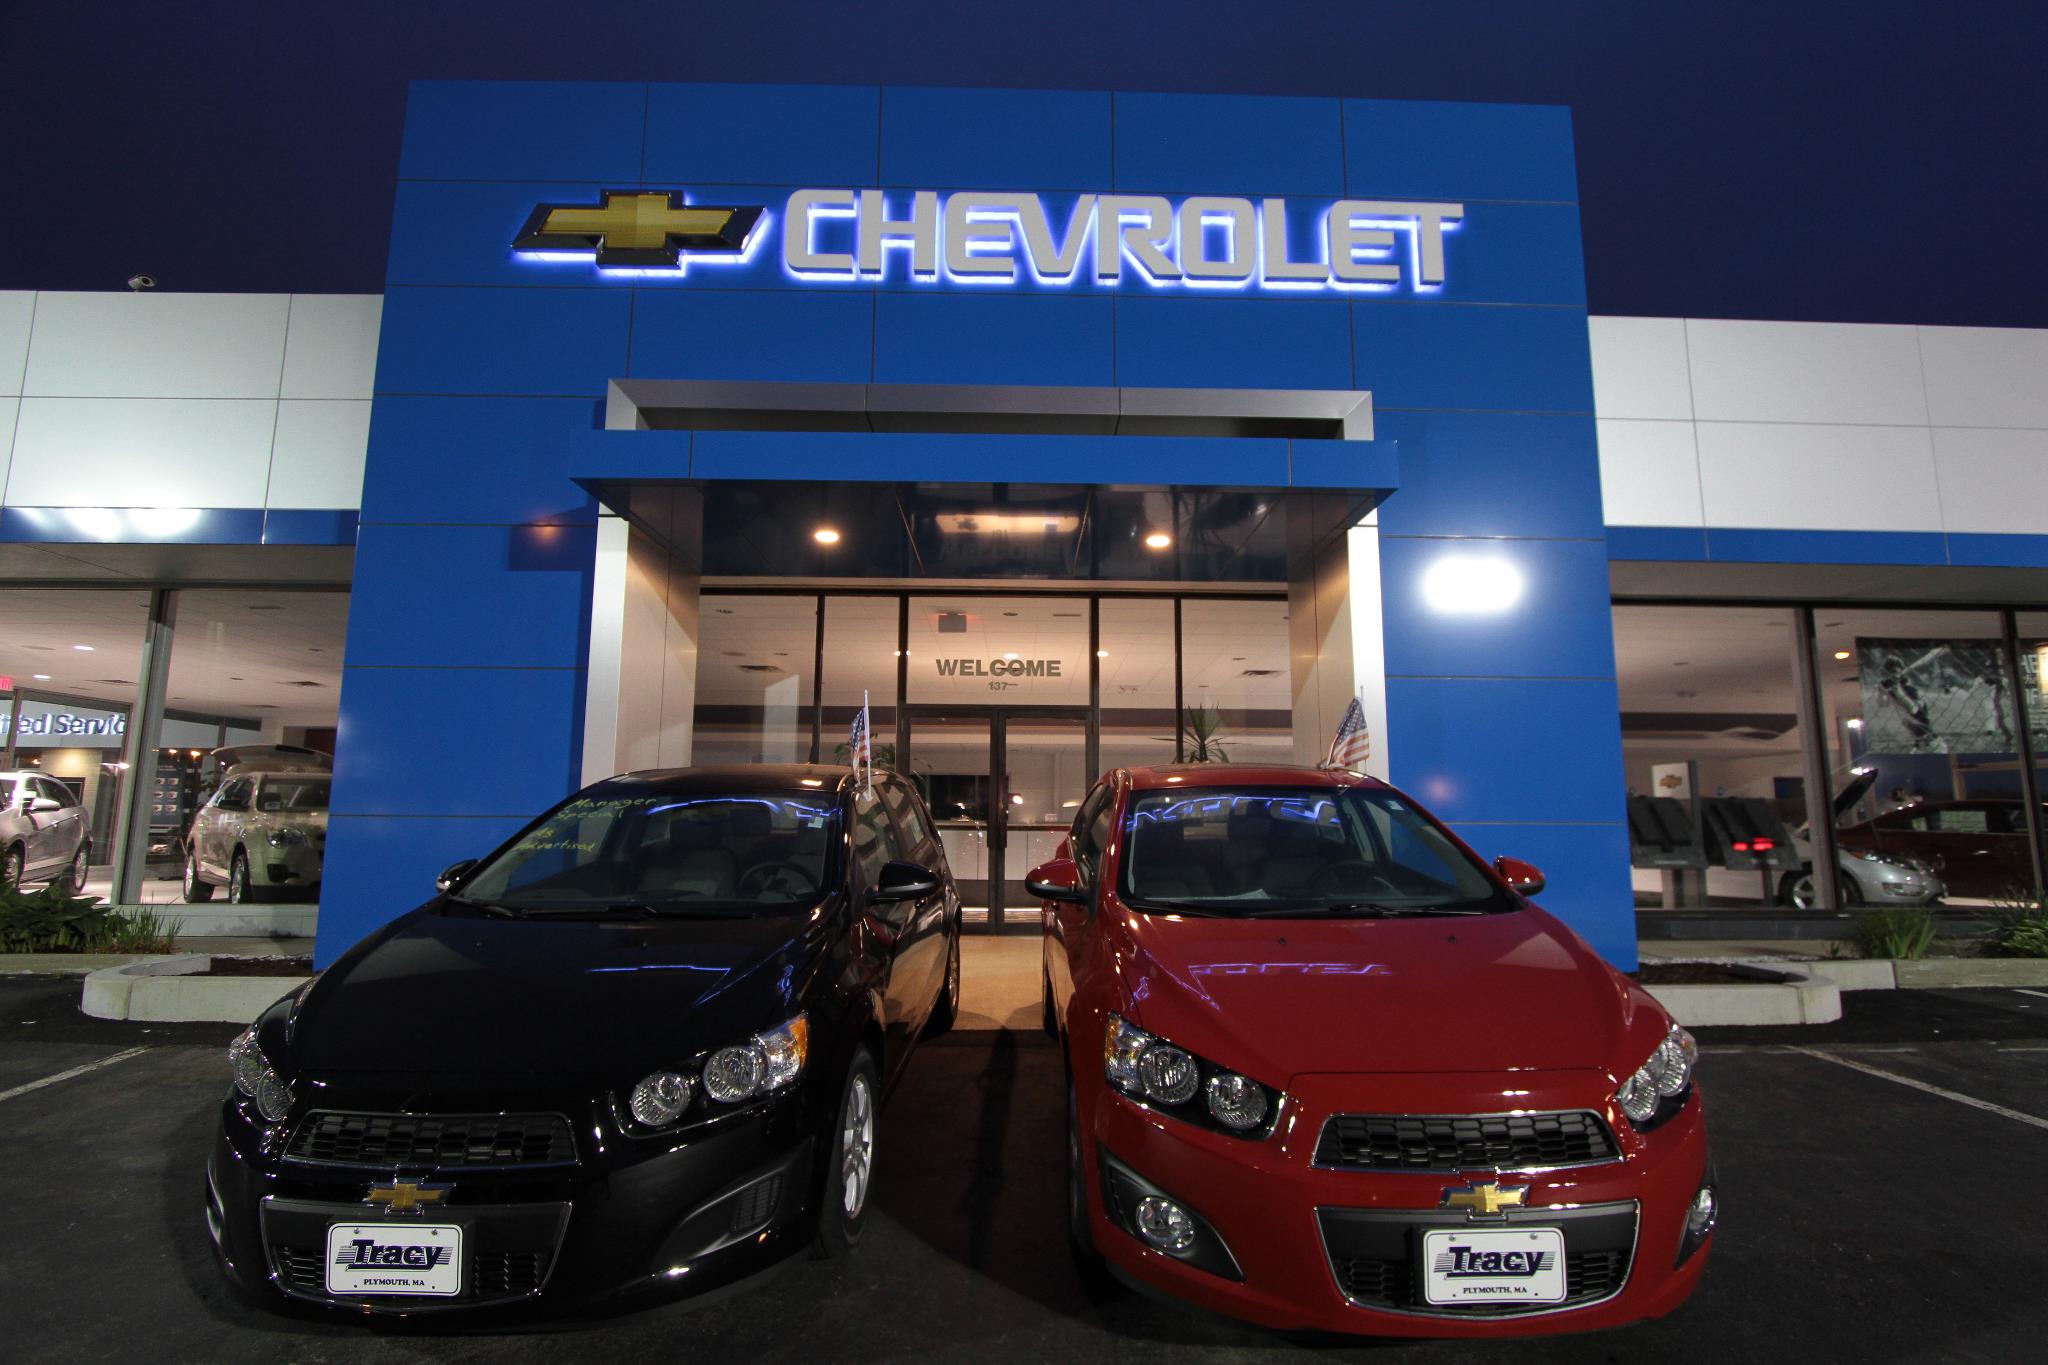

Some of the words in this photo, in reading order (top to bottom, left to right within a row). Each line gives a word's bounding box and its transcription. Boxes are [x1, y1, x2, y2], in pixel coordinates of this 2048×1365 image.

[785, 188, 1464, 286] CHEVROLET
[936, 659, 1062, 677] WELCOME
[988, 681, 1009, 691] 137
[346, 1239, 444, 1272] Tracy
[1444, 1246, 1545, 1280] Tracy
[363, 1278, 411, 1287] PLYMOUTH,
[1463, 1287, 1513, 1295] PLYMOUTH,
